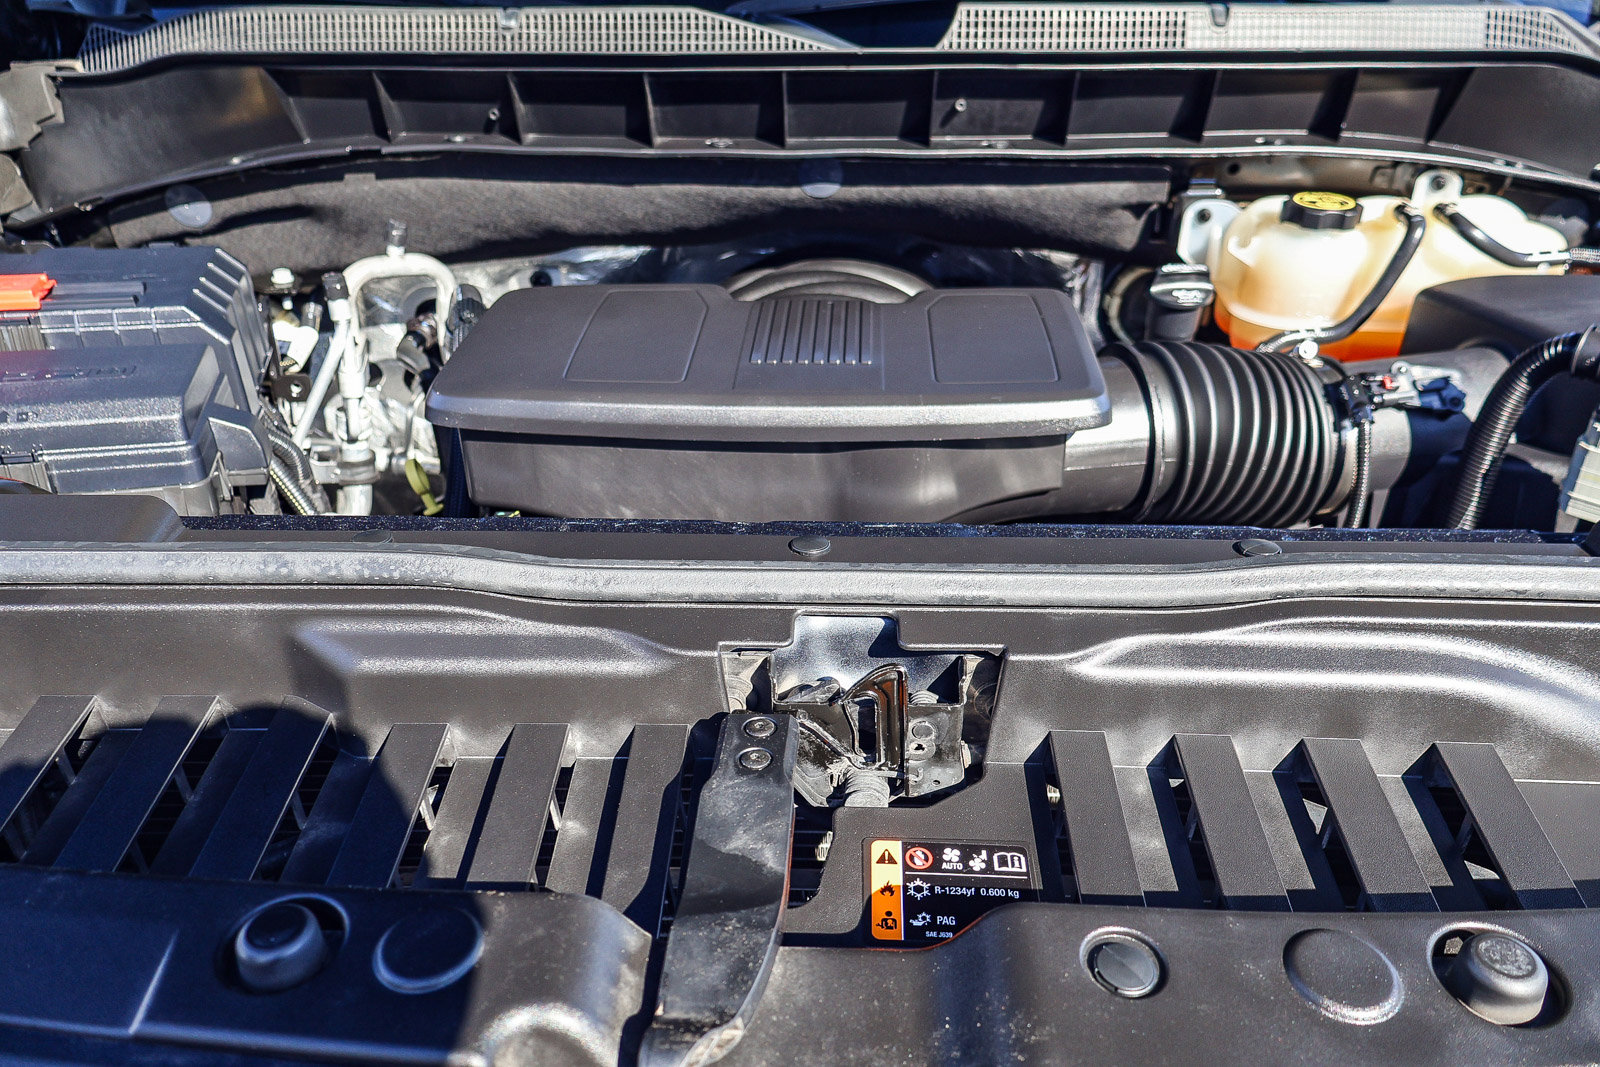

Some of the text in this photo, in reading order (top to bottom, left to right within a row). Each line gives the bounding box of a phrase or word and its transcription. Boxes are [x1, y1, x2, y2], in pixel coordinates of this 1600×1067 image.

[942, 862, 963, 870] AUTO
[935, 886, 1020, 899] R-1234yf 0.600 kg
[936, 916, 956, 926] PAG
